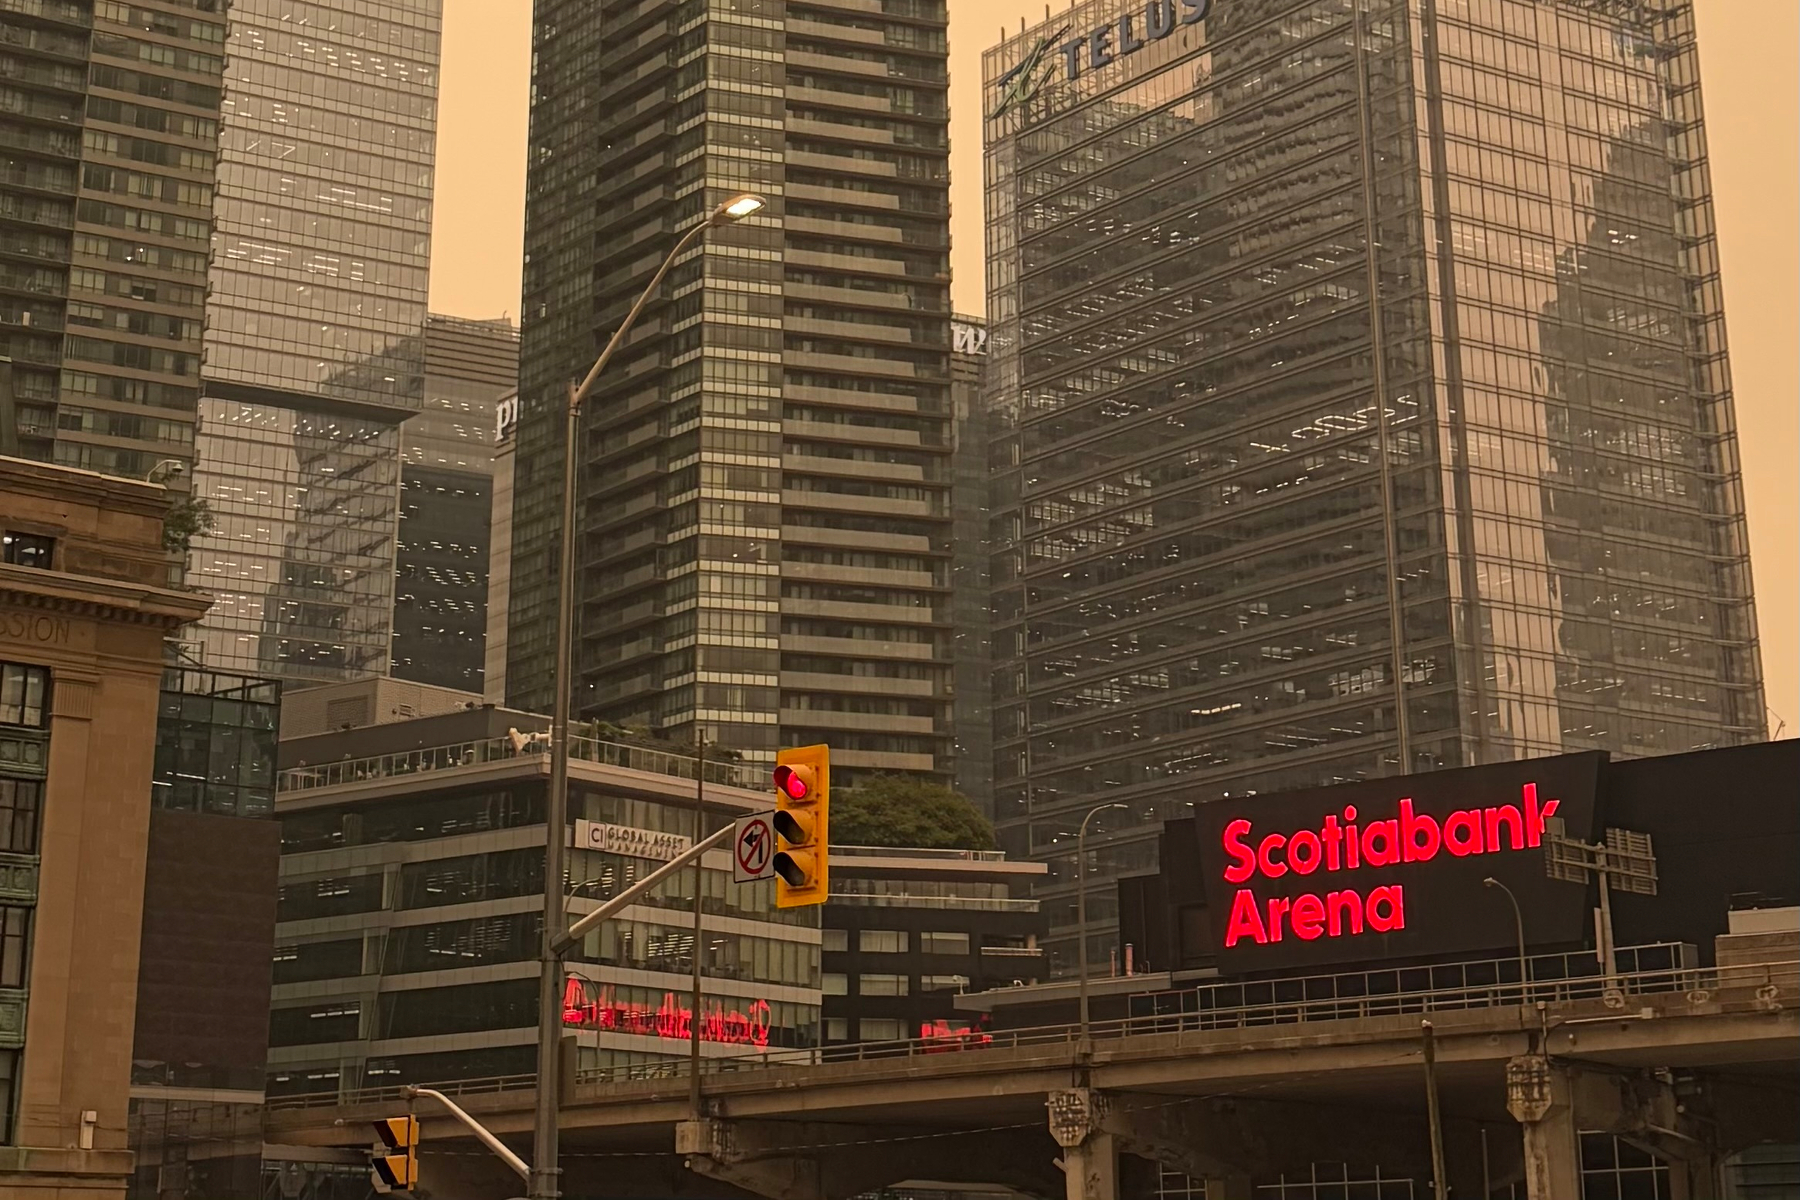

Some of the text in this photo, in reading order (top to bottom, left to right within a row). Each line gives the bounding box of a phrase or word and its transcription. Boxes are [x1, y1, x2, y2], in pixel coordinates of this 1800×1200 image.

[591, 827, 604, 843] CI
[607, 826, 685, 850] GLOBAL ASSET
[1223, 782, 1560, 883] Scotiabank
[1225, 885, 1406, 948] Arena
